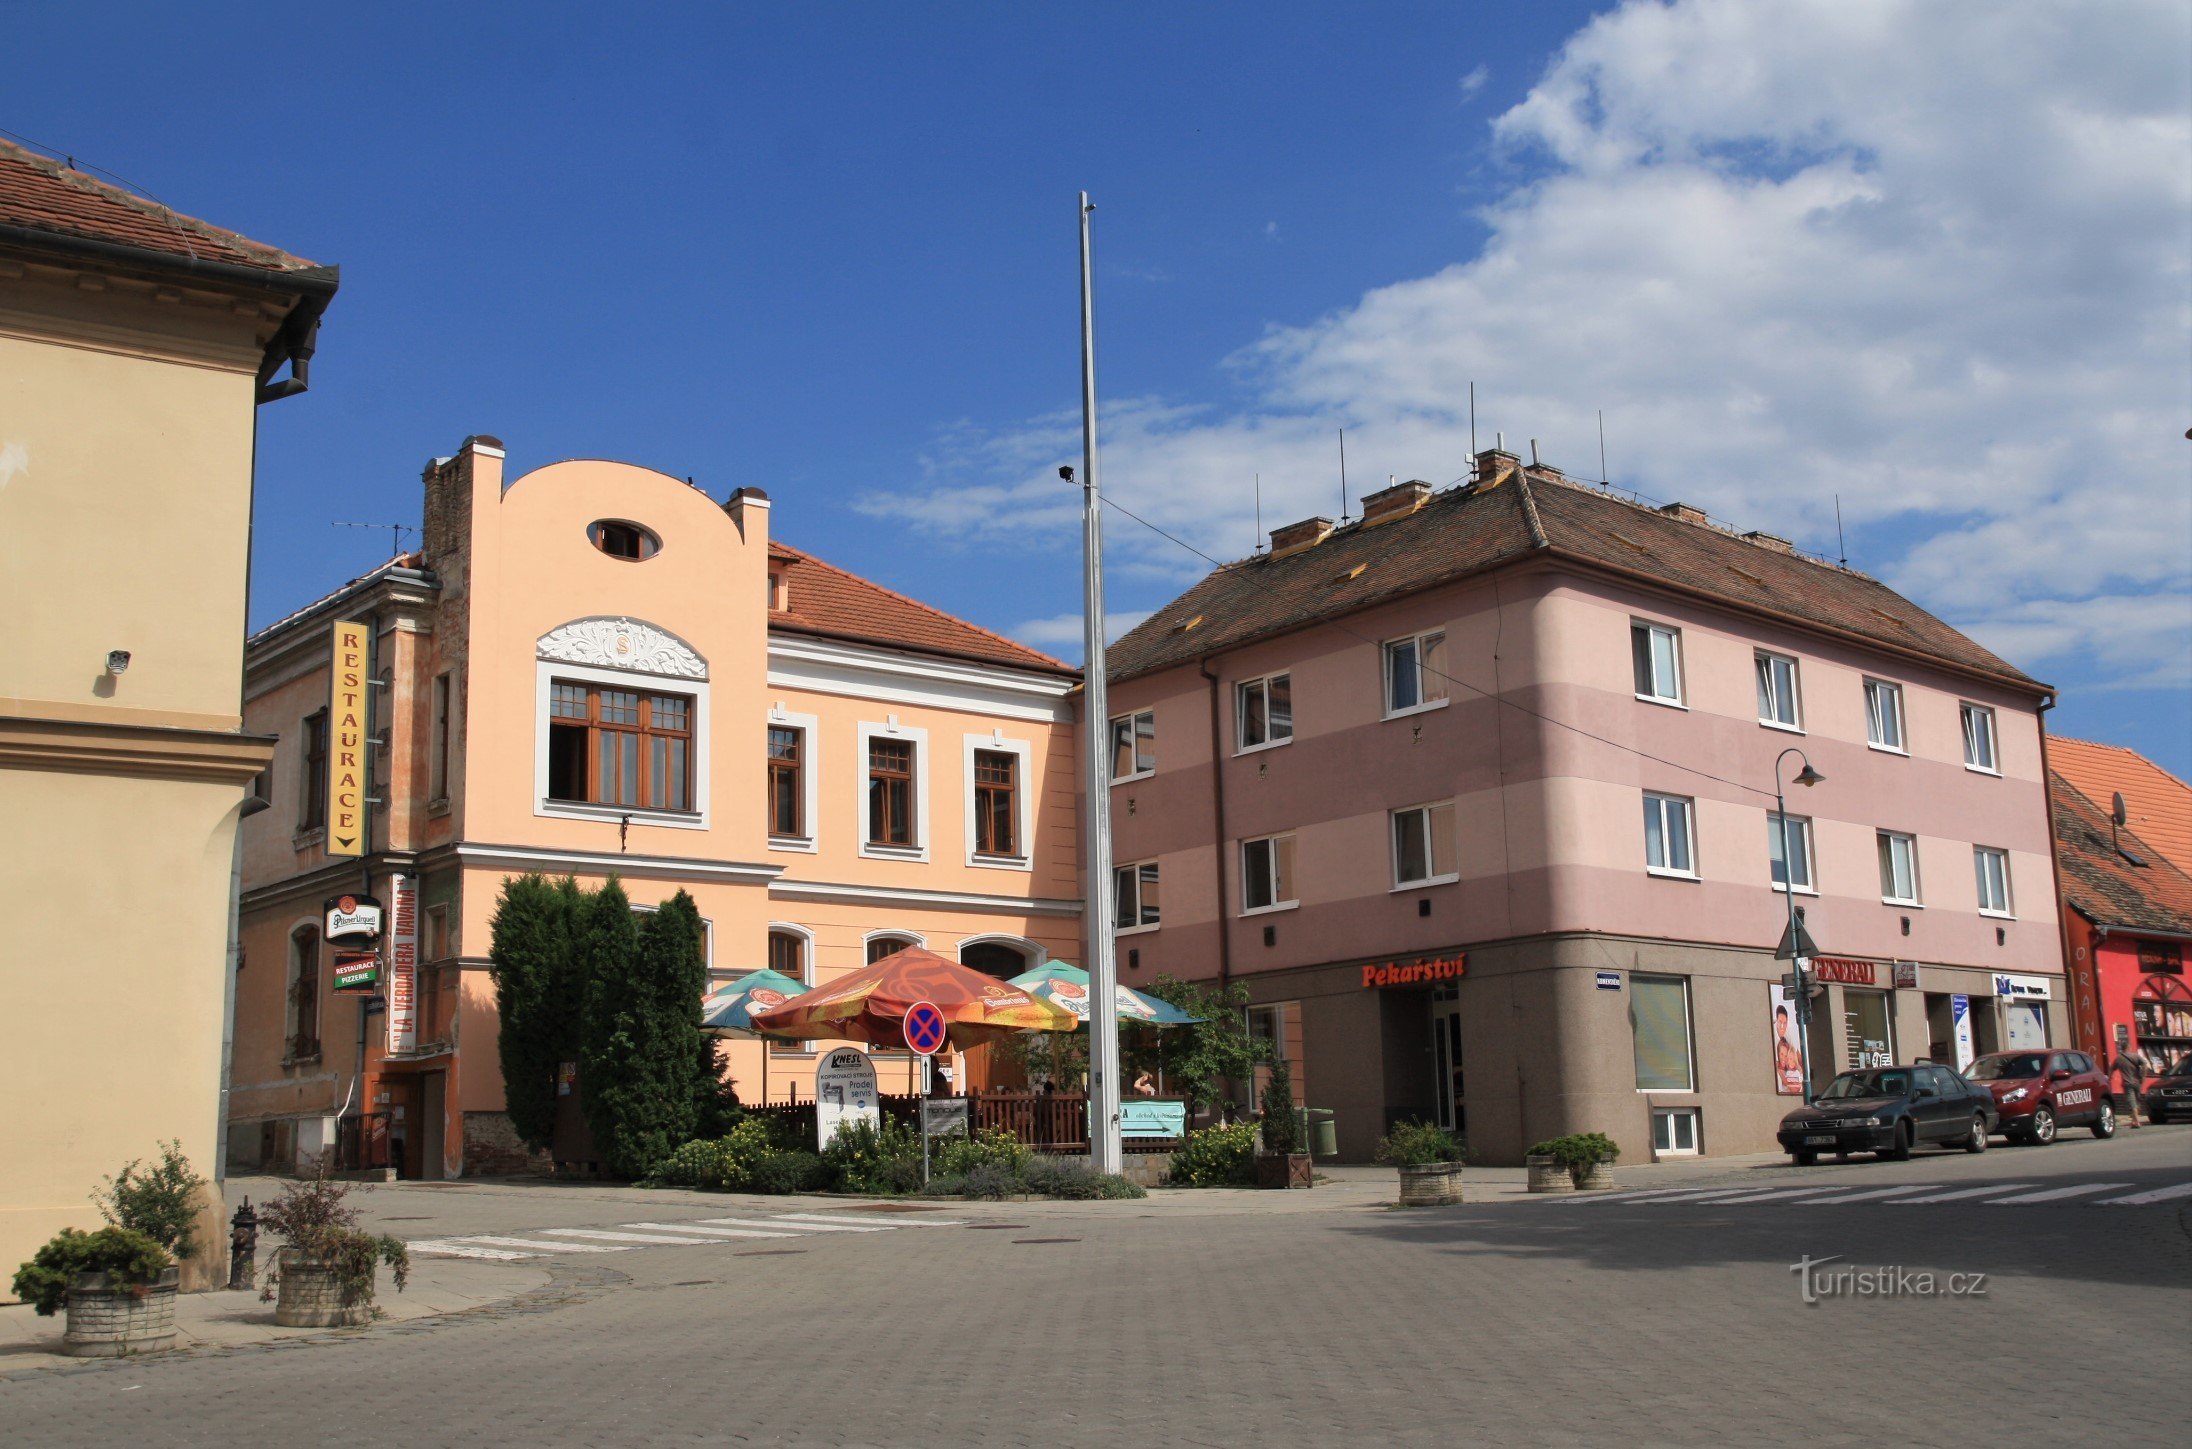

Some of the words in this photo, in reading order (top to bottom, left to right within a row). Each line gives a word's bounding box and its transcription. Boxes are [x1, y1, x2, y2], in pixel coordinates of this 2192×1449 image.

[338, 633, 359, 828] RESTAURACE
[333, 914, 356, 929] Pilsner
[356, 914, 376, 925] Urquell
[336, 961, 375, 975] RESTAURACE
[1362, 952, 1467, 988] Pekařství
[1811, 957, 1877, 985] GENERALI
[341, 973, 369, 984] PIZZERIE
[394, 943, 414, 1011] VERDADERA
[831, 1054, 862, 1069] KNESL
[849, 1080, 873, 1089] Prodej
[851, 1089, 872, 1098] servis
[2063, 1088, 2092, 1105] GENERALI
